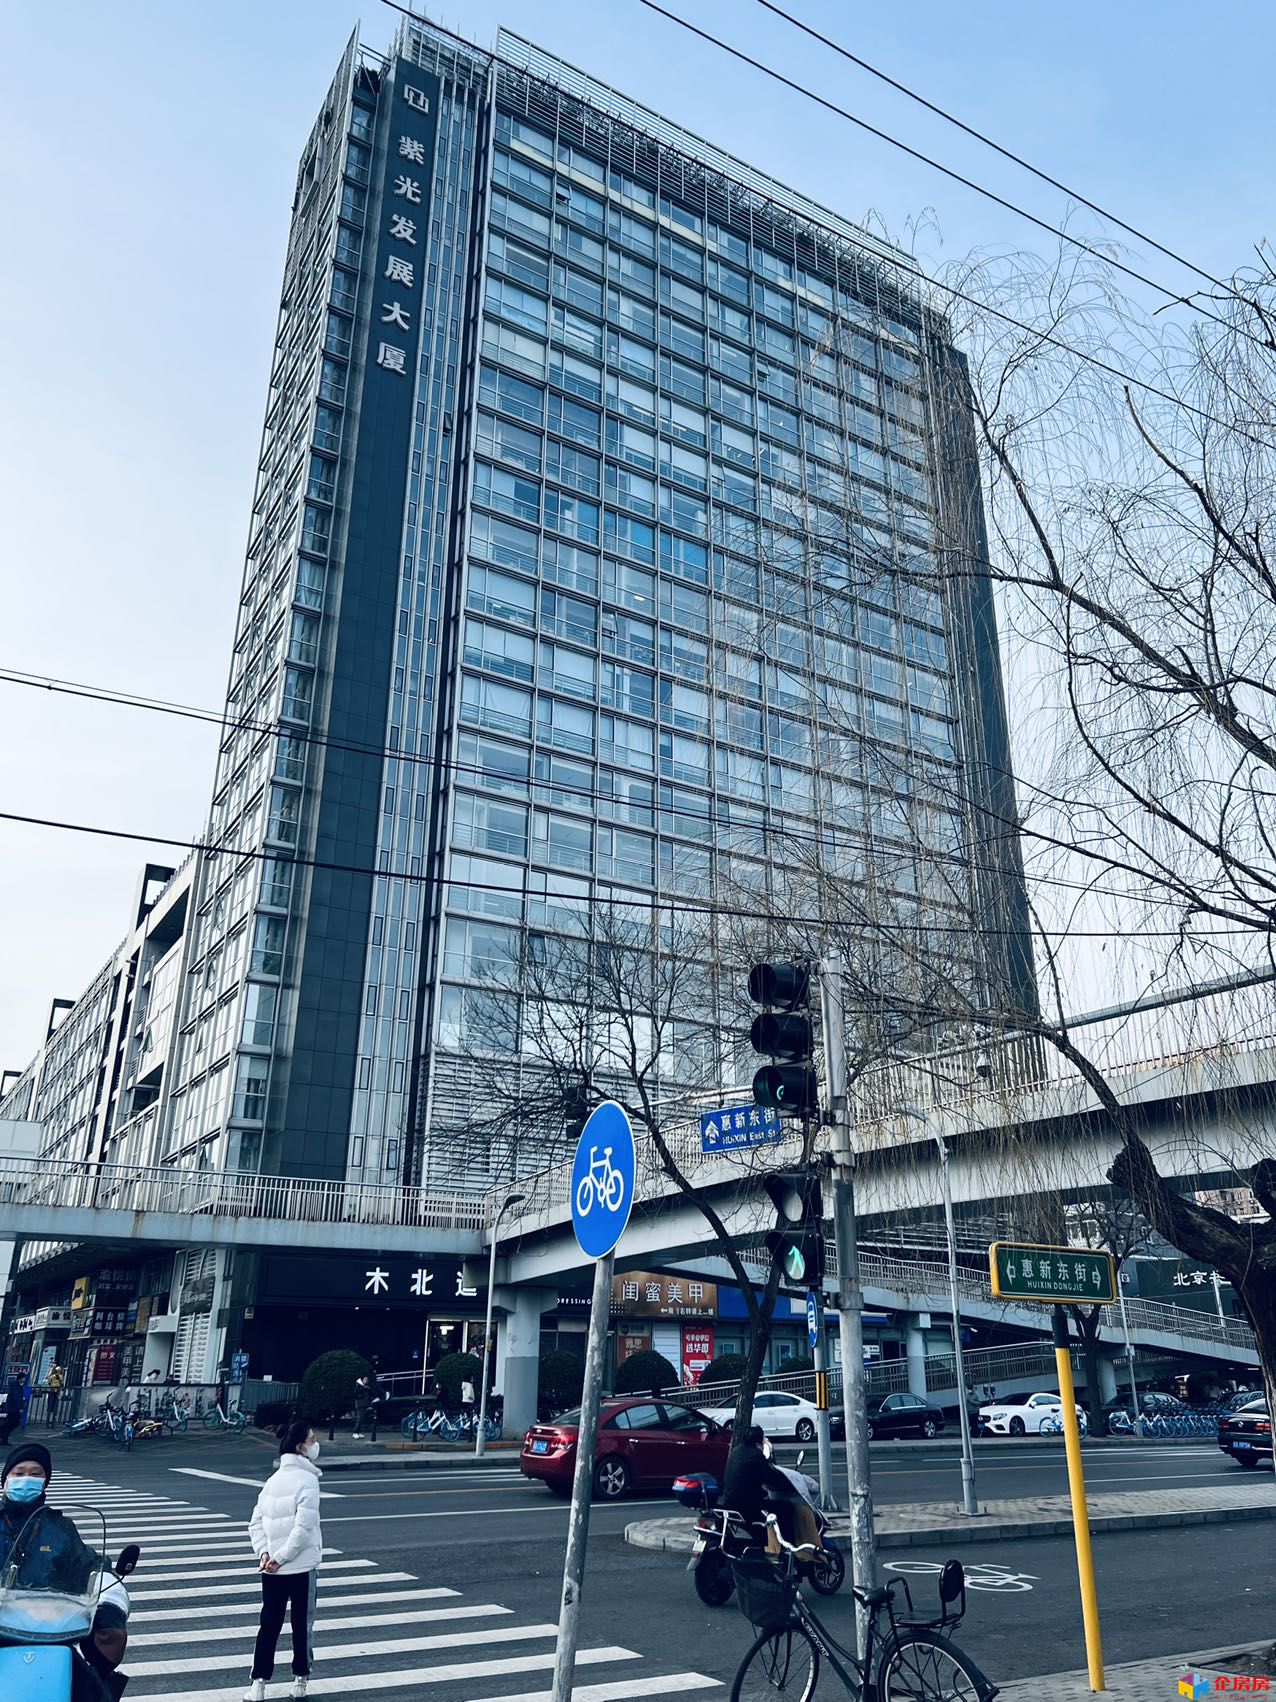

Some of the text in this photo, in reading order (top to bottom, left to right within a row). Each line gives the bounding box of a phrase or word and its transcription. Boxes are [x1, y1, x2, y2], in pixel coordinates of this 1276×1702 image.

[377, 135, 425, 377] 紫光发展大厦
[720, 1107, 775, 1132] 惠新东街
[749, 1130, 765, 1141] East
[1020, 1258, 1087, 1282] 惠新东街
[621, 1280, 704, 1303] 闺蜜美甲
[1027, 1281, 1084, 1292] HUIXIN DONGJIE
